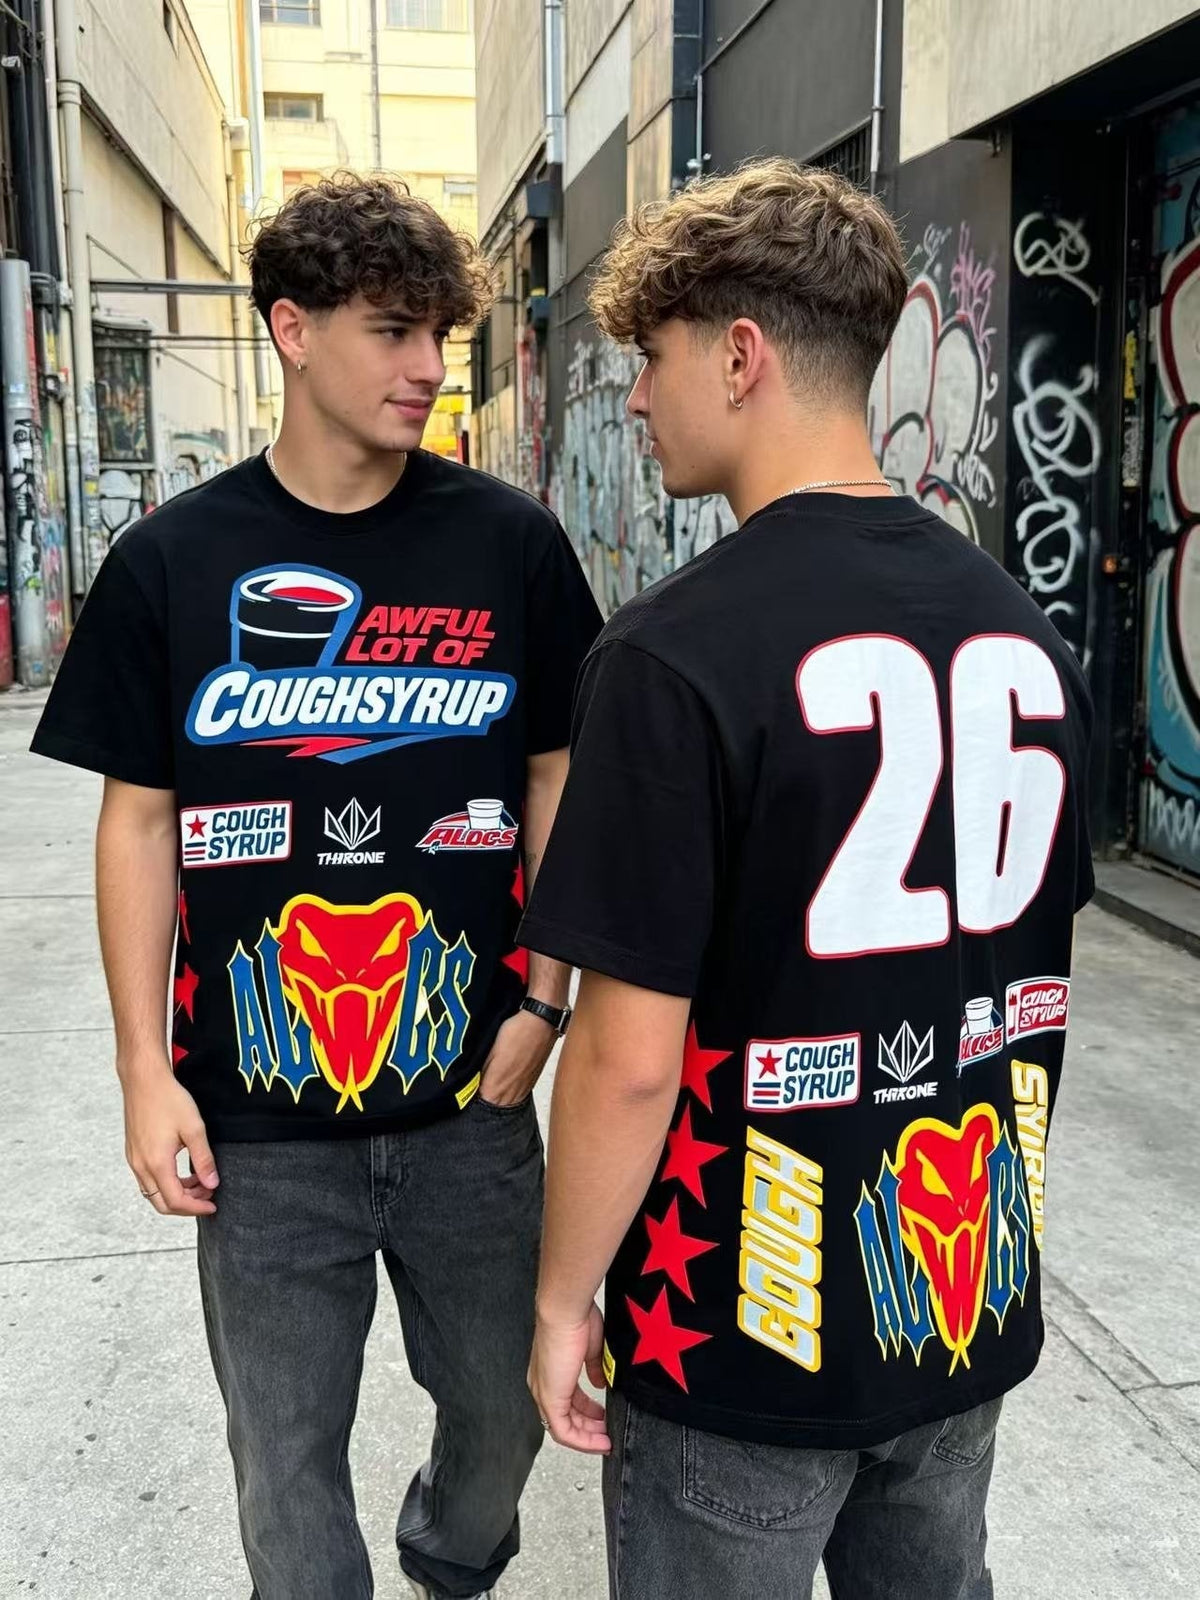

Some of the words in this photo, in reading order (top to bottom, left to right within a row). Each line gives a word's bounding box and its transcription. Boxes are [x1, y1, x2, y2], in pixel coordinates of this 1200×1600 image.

[357, 605, 496, 639] AWFUL
[344, 637, 427, 663] LOT
[432, 639, 490, 665] OF
[194, 670, 508, 738] COUGHSYRUP
[795, 633, 1067, 960] 26
[211, 806, 287, 834] COUGH
[207, 831, 286, 860] SYRUP
[316, 851, 386, 866] THRONE
[785, 1041, 855, 1073] COUGH
[782, 1069, 856, 1105] SYRUP
[736, 1125, 824, 1373] COUGH
